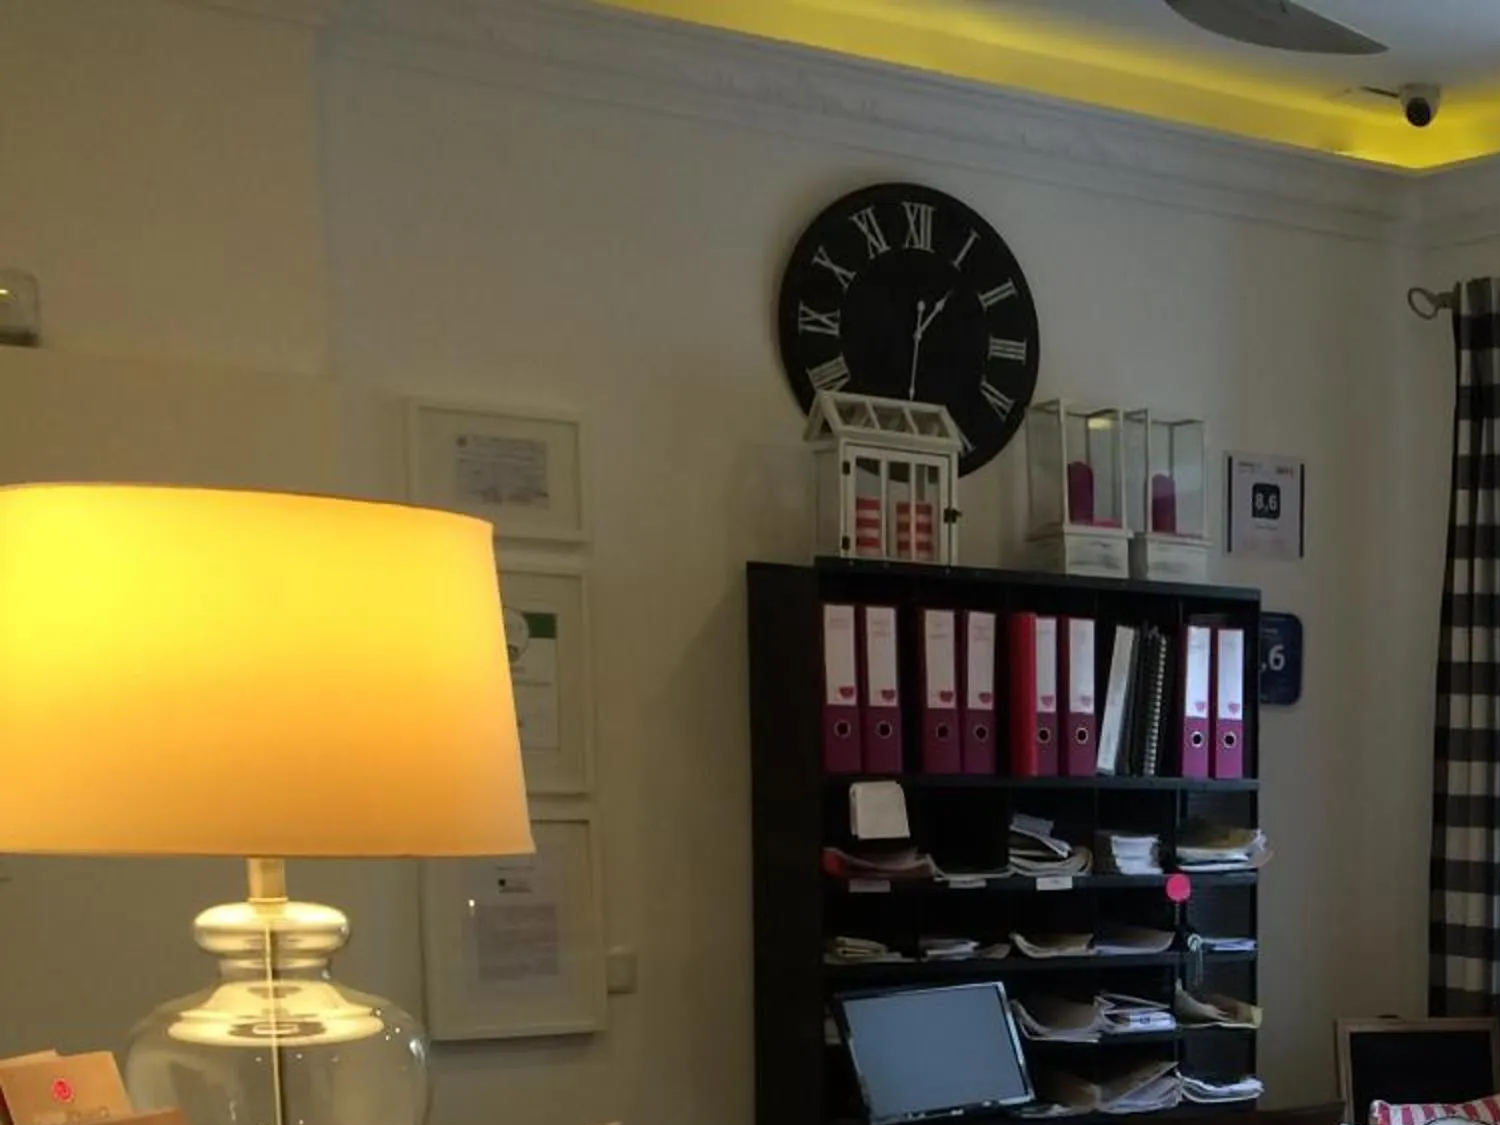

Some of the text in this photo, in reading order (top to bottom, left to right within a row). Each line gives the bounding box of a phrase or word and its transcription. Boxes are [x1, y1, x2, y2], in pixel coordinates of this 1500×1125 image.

[849, 205, 891, 260] XI
[902, 201, 935, 253] XII
[811, 245, 857, 289] X
[797, 301, 841, 337] IX
